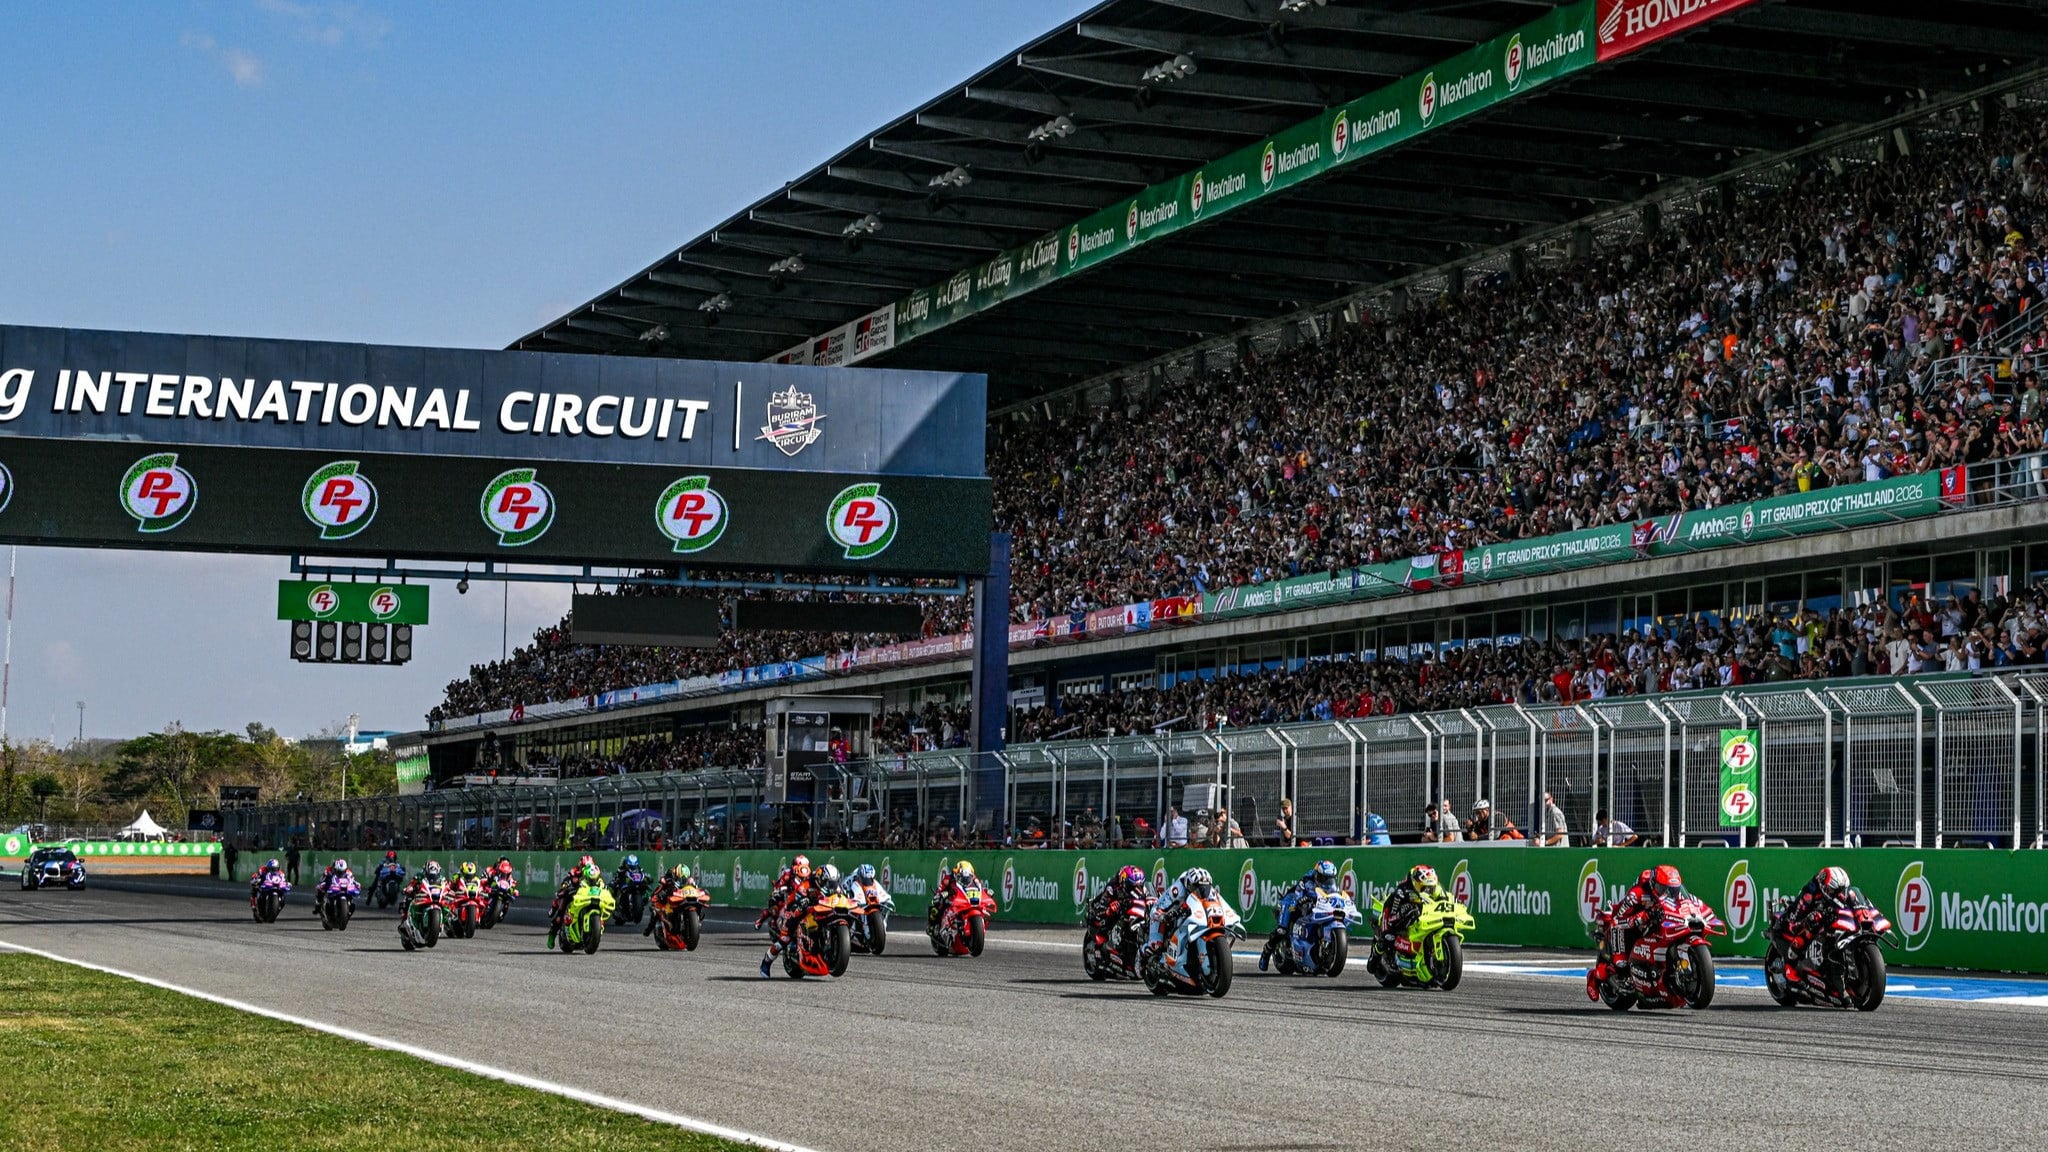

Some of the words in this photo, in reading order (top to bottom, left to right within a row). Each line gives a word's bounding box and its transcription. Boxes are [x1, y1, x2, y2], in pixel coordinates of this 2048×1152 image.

[1527, 29, 1585, 70] Maxnitron
[1439, 69, 1492, 108] Maxnitron
[1352, 108, 1401, 144] Maxnitron
[1278, 142, 1320, 175] Maxnitron
[1206, 173, 1246, 203] Maxnitron
[1139, 200, 1178, 230] Maxnitron
[1032, 241, 1059, 269] Chang
[1080, 227, 1115, 254] Maxnitron
[53, 369, 482, 431] INTERNATIONAL
[499, 390, 710, 440] CIRCUIT
[771, 407, 813, 423] BURIRAM
[138, 471, 181, 516] PT
[320, 479, 362, 523] PT
[498, 486, 539, 530] PT
[1760, 508, 1773, 524] PT
[1773, 503, 1804, 522] GRAND
[1805, 500, 1830, 517] PRIX
[1831, 497, 1844, 513] OF
[1843, 489, 1895, 511] THAILAND
[1895, 483, 1923, 502] 2026
[673, 493, 714, 536] PT
[844, 500, 884, 543] PT
[1497, 551, 1507, 565] PT
[1506, 548, 1530, 564] GRAND
[1530, 546, 1550, 561] PRIX
[1550, 543, 1561, 558] OF
[1561, 537, 1600, 556] THAILAND
[1600, 533, 1621, 549] 2026
[315, 592, 333, 610] PT
[377, 594, 394, 612] PT
[1285, 586, 1293, 598] PT
[1293, 583, 1312, 597] GRAND
[1312, 581, 1328, 594] PRIX
[1328, 580, 1336, 592] OF
[1731, 744, 1750, 765] PT
[1730, 792, 1750, 813] PT
[1017, 876, 1059, 900] Maxnitron
[1242, 873, 1254, 909] PT
[1478, 883, 1551, 916] Maxnitron
[1585, 878, 1600, 919] PT
[1732, 879, 1751, 926] PT
[1434, 902, 1455, 913] 49
[1904, 883, 1926, 932] PT
